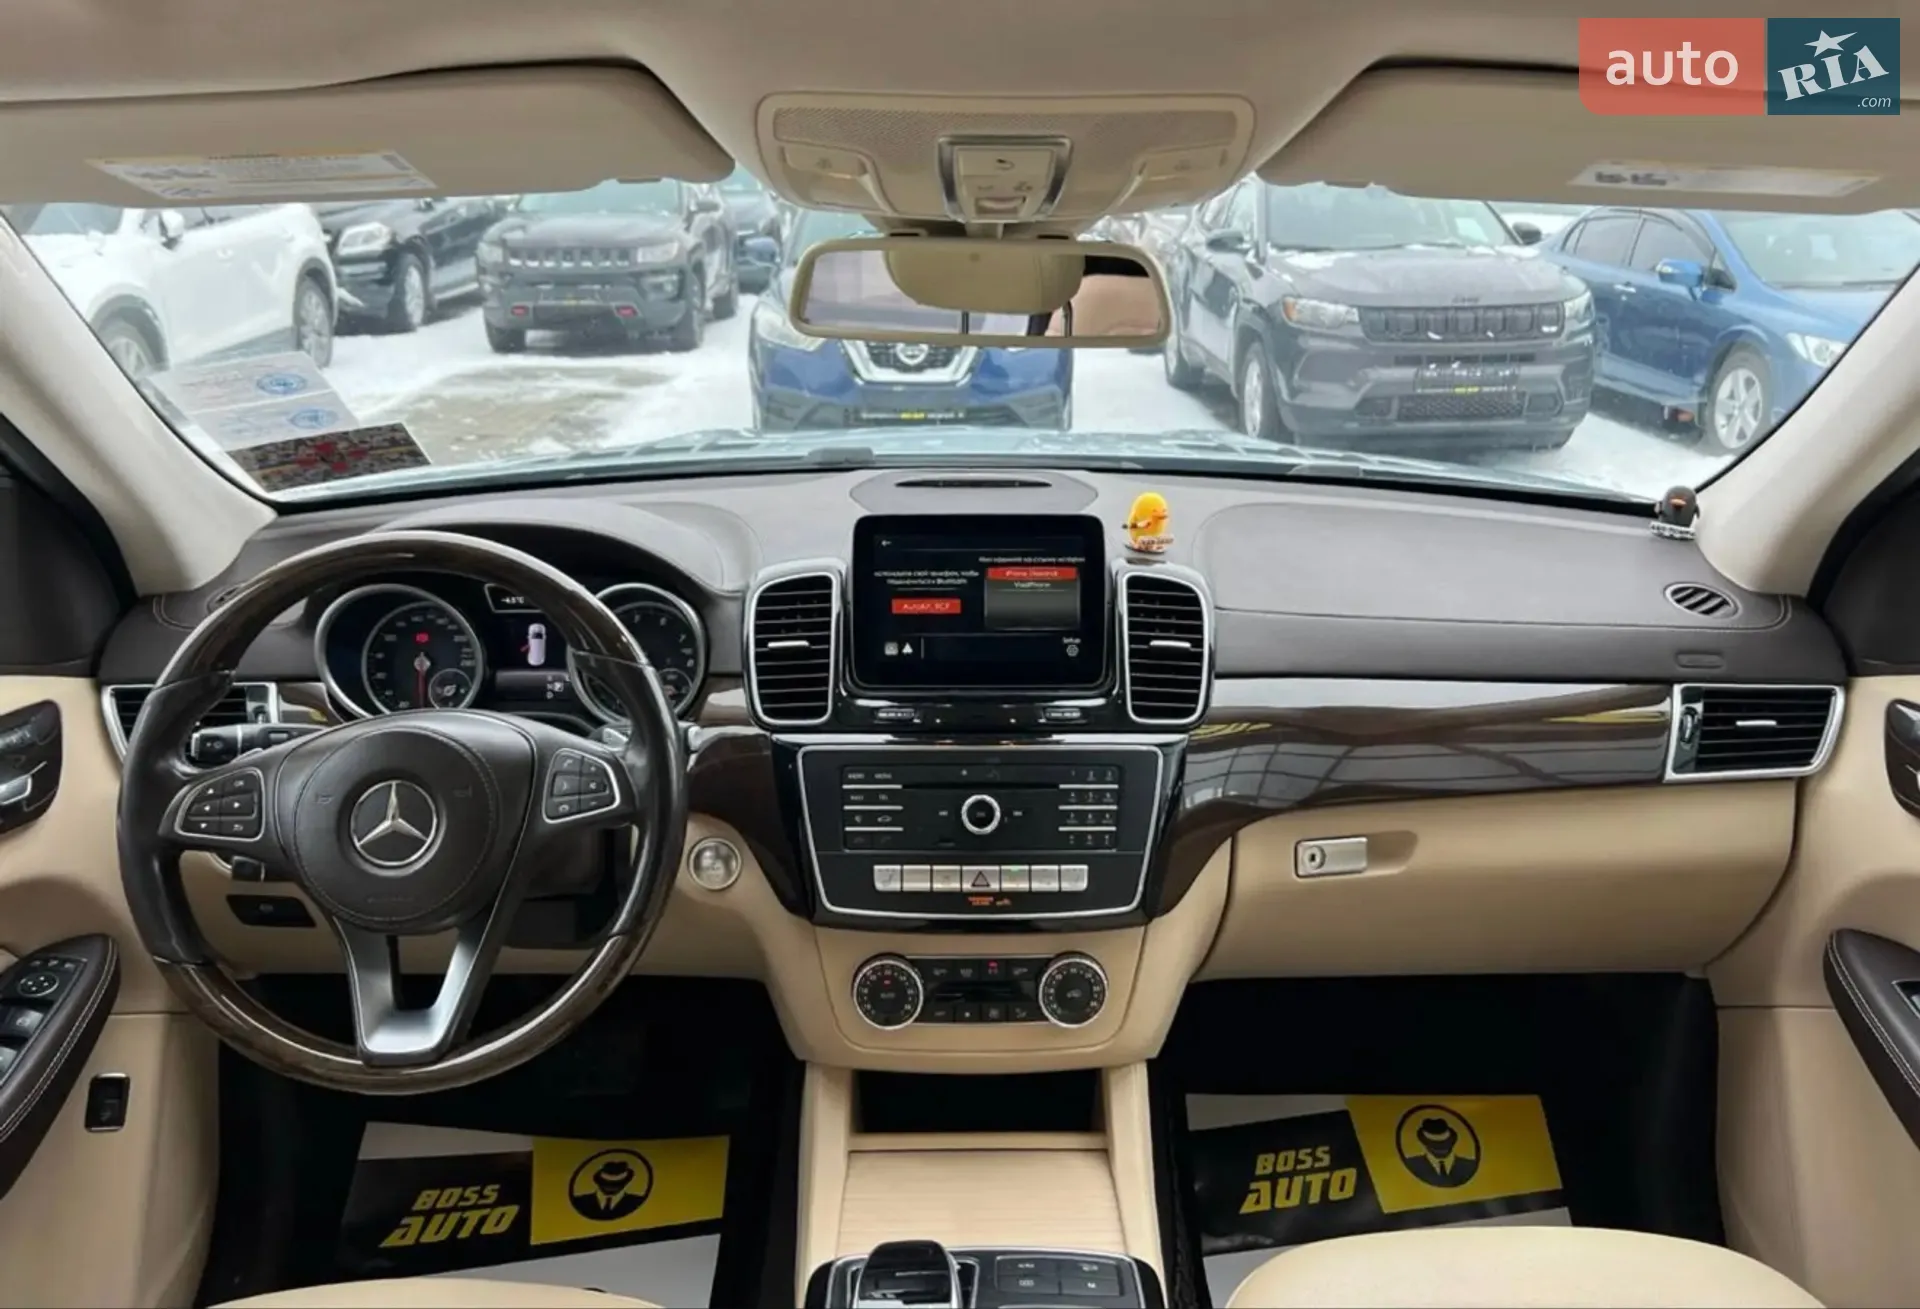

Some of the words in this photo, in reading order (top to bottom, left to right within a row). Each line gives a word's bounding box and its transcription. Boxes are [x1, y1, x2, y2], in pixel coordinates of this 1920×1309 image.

[1255, 1145, 1332, 1176] BOSS
[411, 1183, 501, 1212] BOSS
[1239, 1167, 1358, 1215] AUTO
[379, 1204, 520, 1249] AUTO
